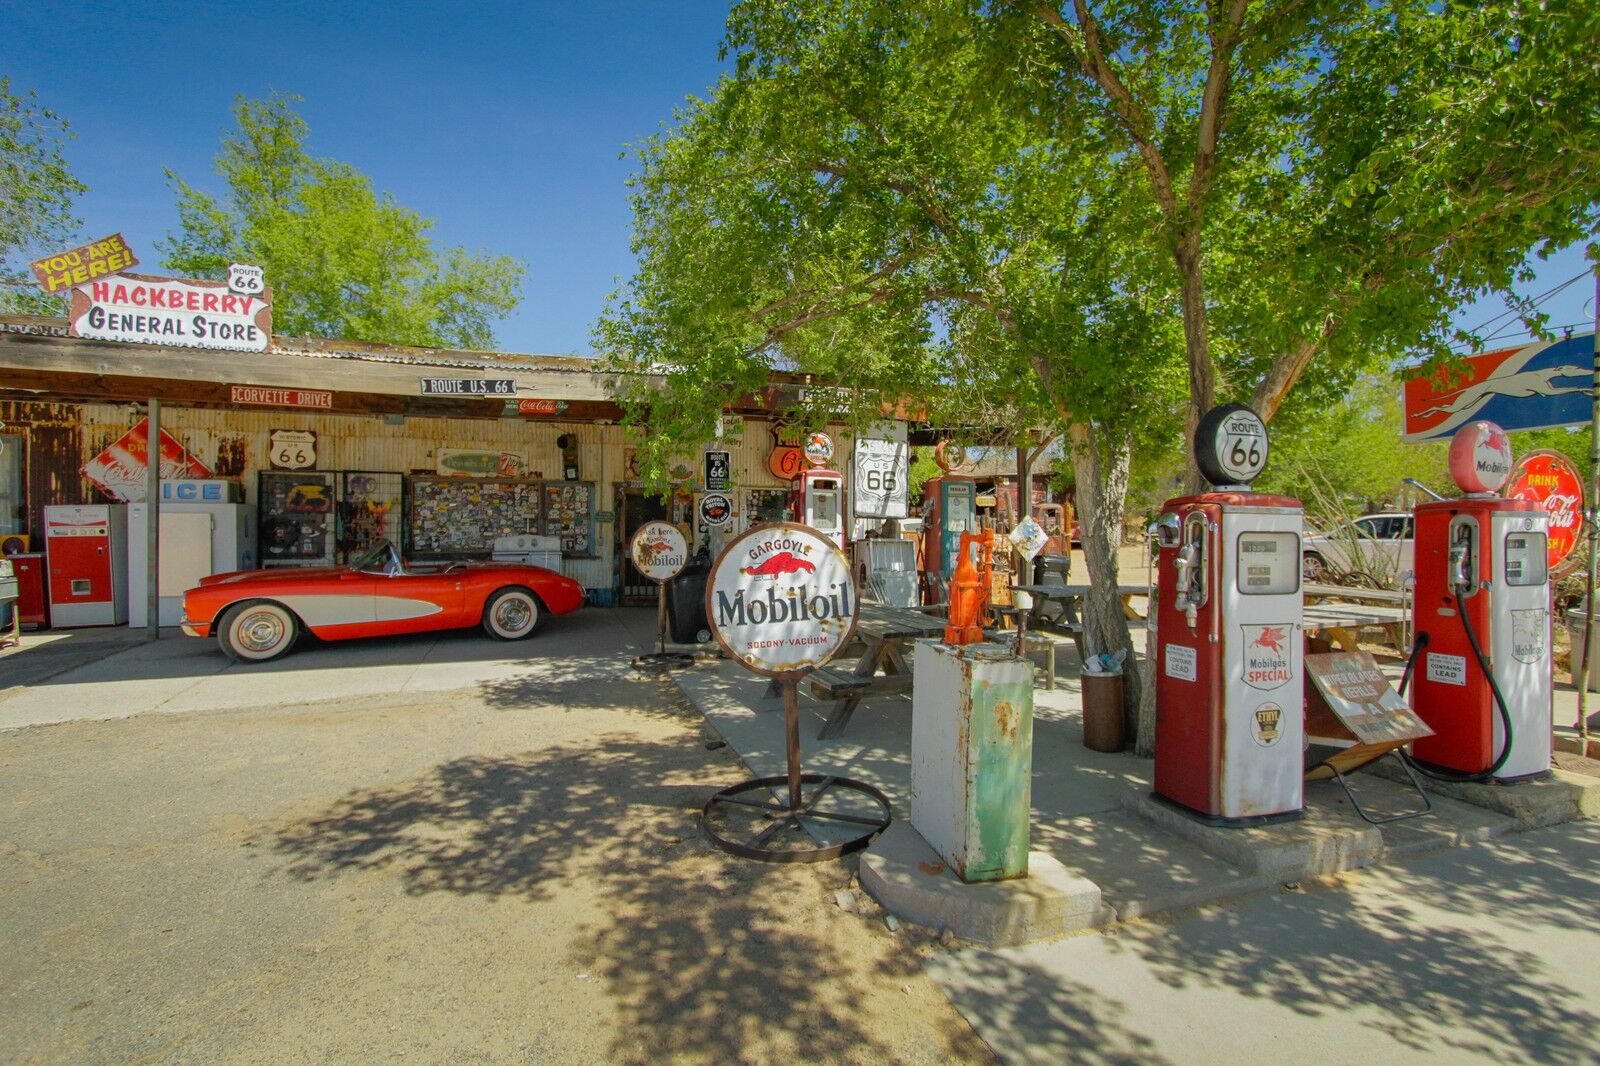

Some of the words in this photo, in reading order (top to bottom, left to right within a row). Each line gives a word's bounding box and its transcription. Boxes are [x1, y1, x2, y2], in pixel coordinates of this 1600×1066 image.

[37, 252, 82, 275] YOU
[89, 238, 123, 260] ARE
[48, 250, 132, 291] HERE!
[233, 268, 260, 276] ROUTE
[235, 277, 258, 289] 66
[92, 282, 253, 316] HACKBERRY
[88, 306, 185, 336] GENERAL
[192, 315, 257, 342] STORE
[430, 380, 462, 393] ROUTE
[470, 380, 489, 394] U.S.
[494, 380, 508, 393] 66
[237, 387, 289, 404] CORVETTE
[297, 392, 328, 406] DRIVE
[1231, 423, 1260, 433] ROUTE
[128, 443, 168, 453] DRK
[1230, 437, 1260, 467] 66
[280, 449, 306, 463] 66
[710, 467, 725, 478] 66
[1476, 460, 1508, 475] Mobil
[867, 470, 896, 490] 66
[1528, 474, 1559, 487] DRINK
[163, 483, 221, 500] ICE
[748, 538, 809, 561] GARGOYLE
[639, 555, 685, 567] Mobiloil
[716, 580, 852, 627] Mobiloil
[1171, 663, 1190, 674] LEAD
[1249, 657, 1287, 670] Mobilgas
[1430, 663, 1462, 673] CONTAINS
[1248, 670, 1288, 683] SPECIAL
[1435, 669, 1457, 679] LEAD
[1257, 711, 1278, 722] ETHYL
